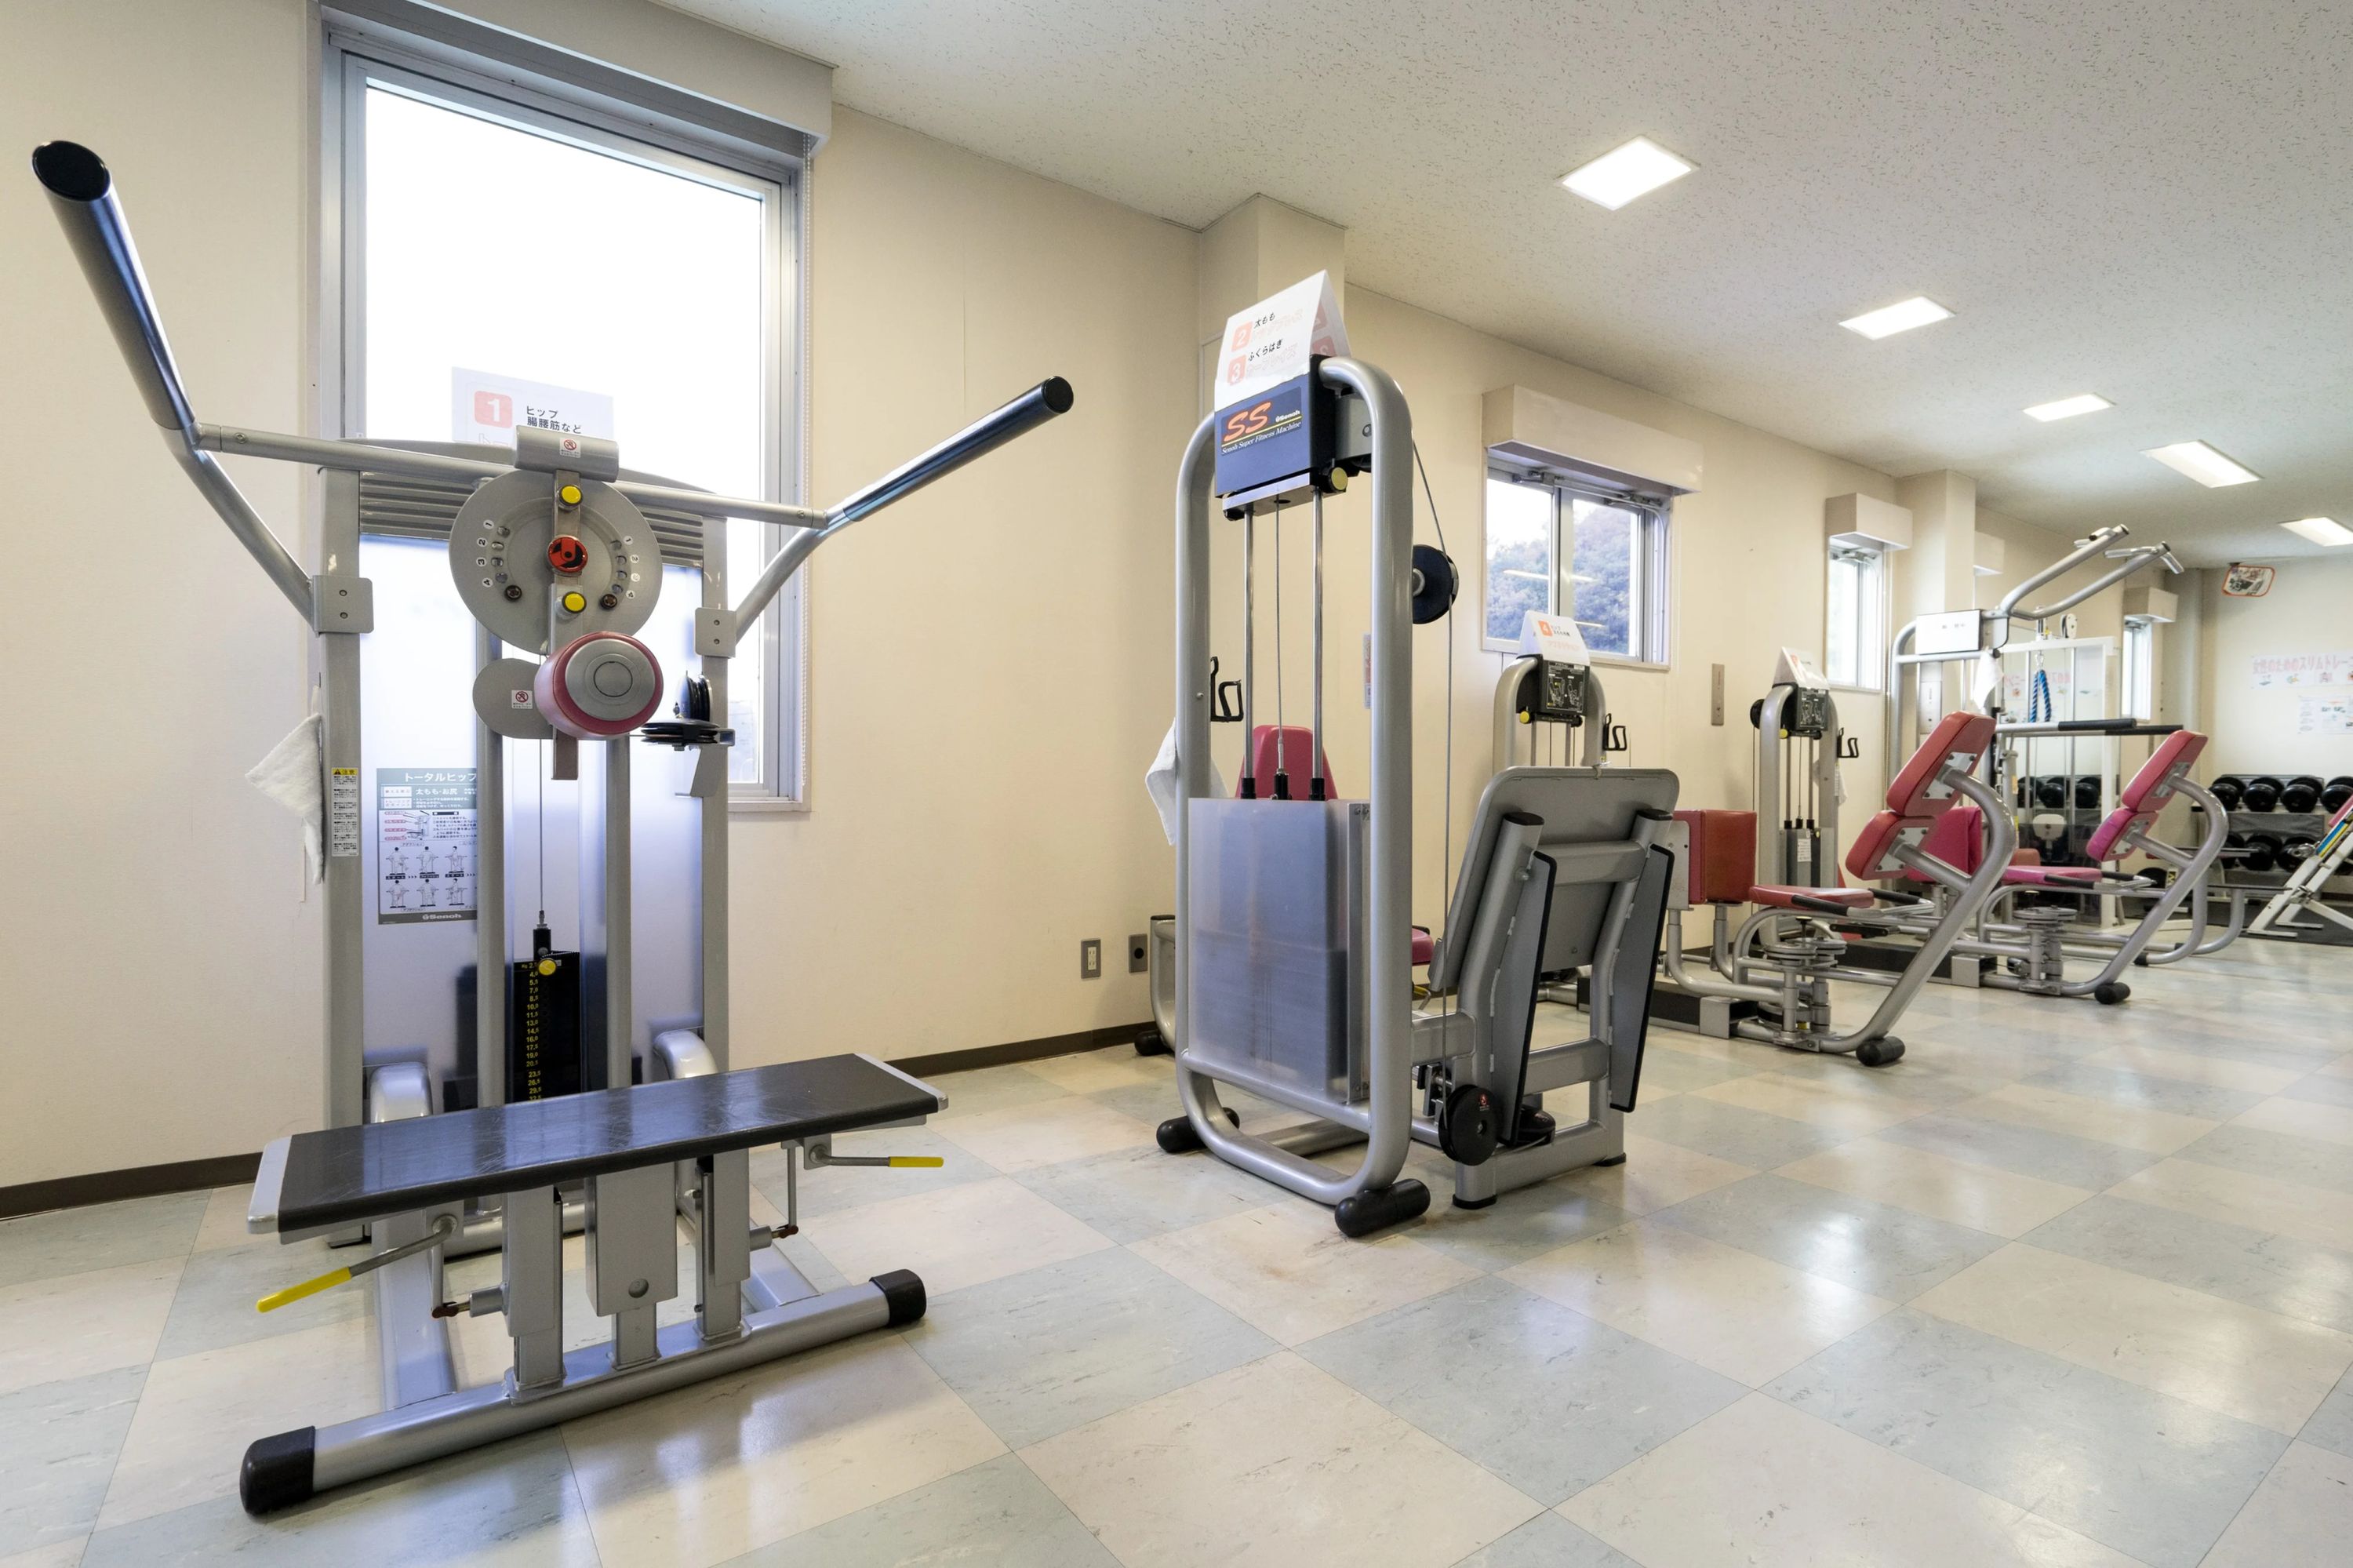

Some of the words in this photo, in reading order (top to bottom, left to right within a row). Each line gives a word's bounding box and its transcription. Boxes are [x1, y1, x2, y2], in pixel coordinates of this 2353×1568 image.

[1253, 311, 1275, 329] 太もも
[1236, 329, 1247, 347] 2
[1248, 338, 1284, 362] ふくらはぎ
[1232, 363, 1241, 383] 3
[487, 398, 501, 423] 1
[526, 406, 558, 419] ヒップ
[527, 416, 582, 435] 腸腰筋など
[1223, 402, 1271, 442] SS
[1221, 444, 1238, 455] Senoh
[1238, 438, 1255, 449] Super
[1255, 431, 1275, 443] Fitness
[1275, 421, 1301, 435] Machine
